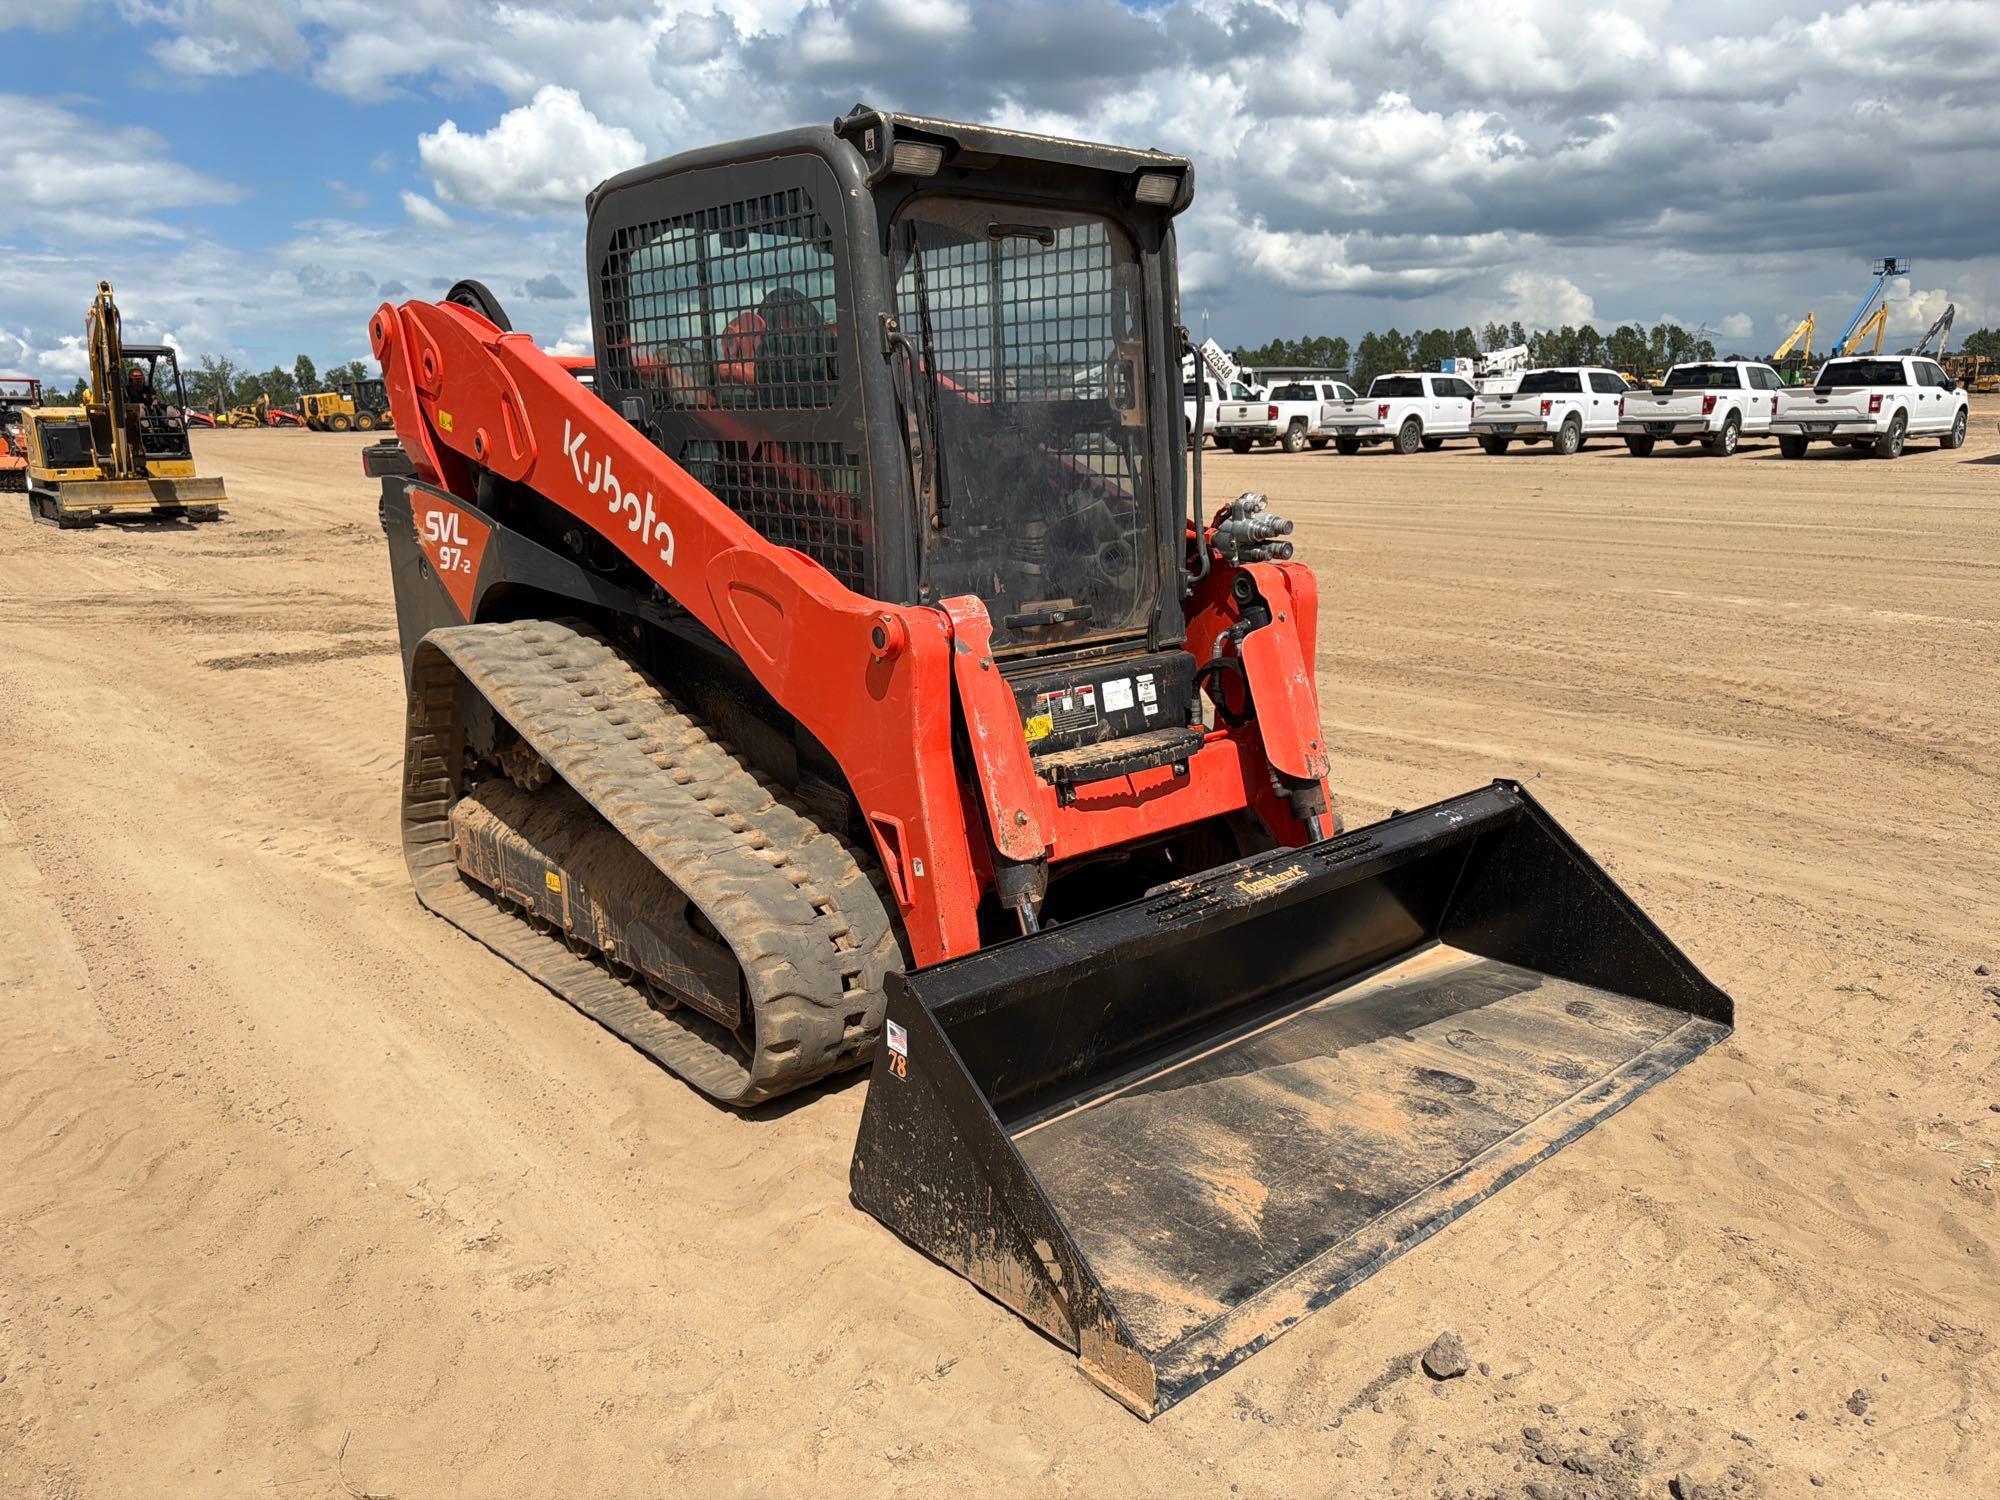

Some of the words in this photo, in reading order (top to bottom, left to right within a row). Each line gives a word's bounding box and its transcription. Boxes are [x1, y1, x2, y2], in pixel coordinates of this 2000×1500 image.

[1206, 348, 1233, 379] 225348
[563, 418, 675, 568] Kubota
[425, 510, 469, 546] SVL
[888, 1049, 907, 1078] 78
